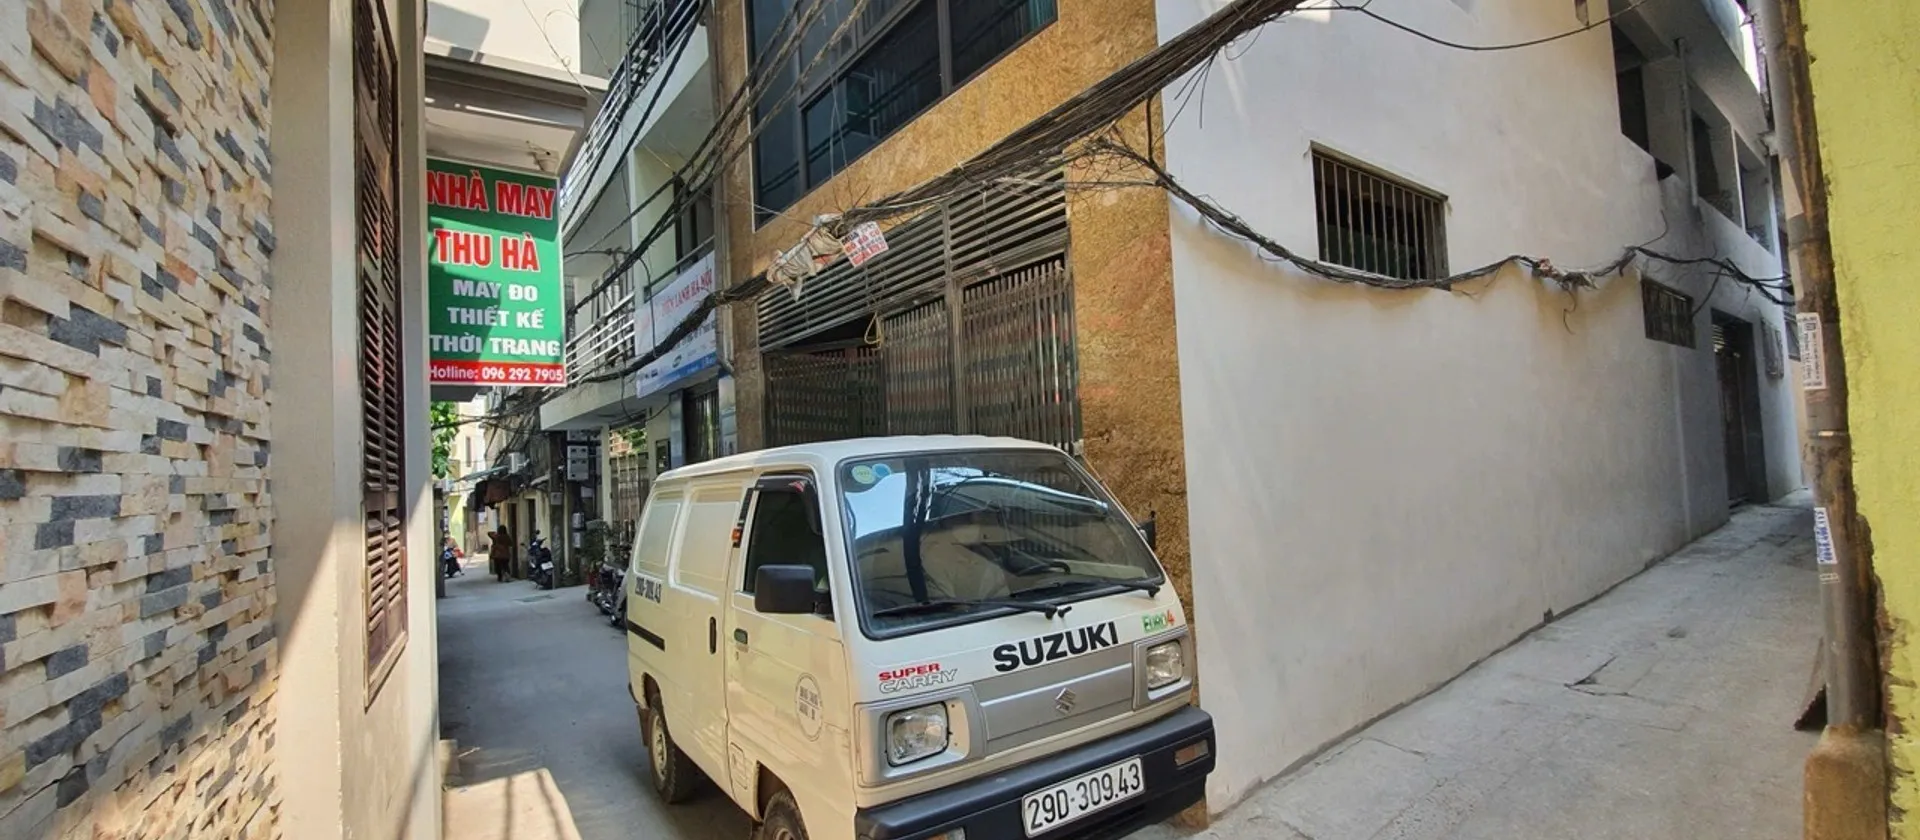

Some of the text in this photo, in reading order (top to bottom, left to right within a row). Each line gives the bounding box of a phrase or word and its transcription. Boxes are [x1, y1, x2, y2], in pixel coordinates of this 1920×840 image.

[427, 170, 556, 220] NHÀ MAY
[434, 229, 540, 272] THU HÀ
[453, 279, 538, 302] MAY ĐO
[447, 305, 545, 329] THIẾT KẾ
[430, 332, 561, 356] THỜI TRANG
[430, 365, 563, 381] Hotline: 096 292 7905
[993, 620, 1119, 672] SUZUKI
[878, 663, 941, 681] SUPER
[879, 668, 958, 694] CARRY
[1027, 763, 1140, 830] 29D-309.43
